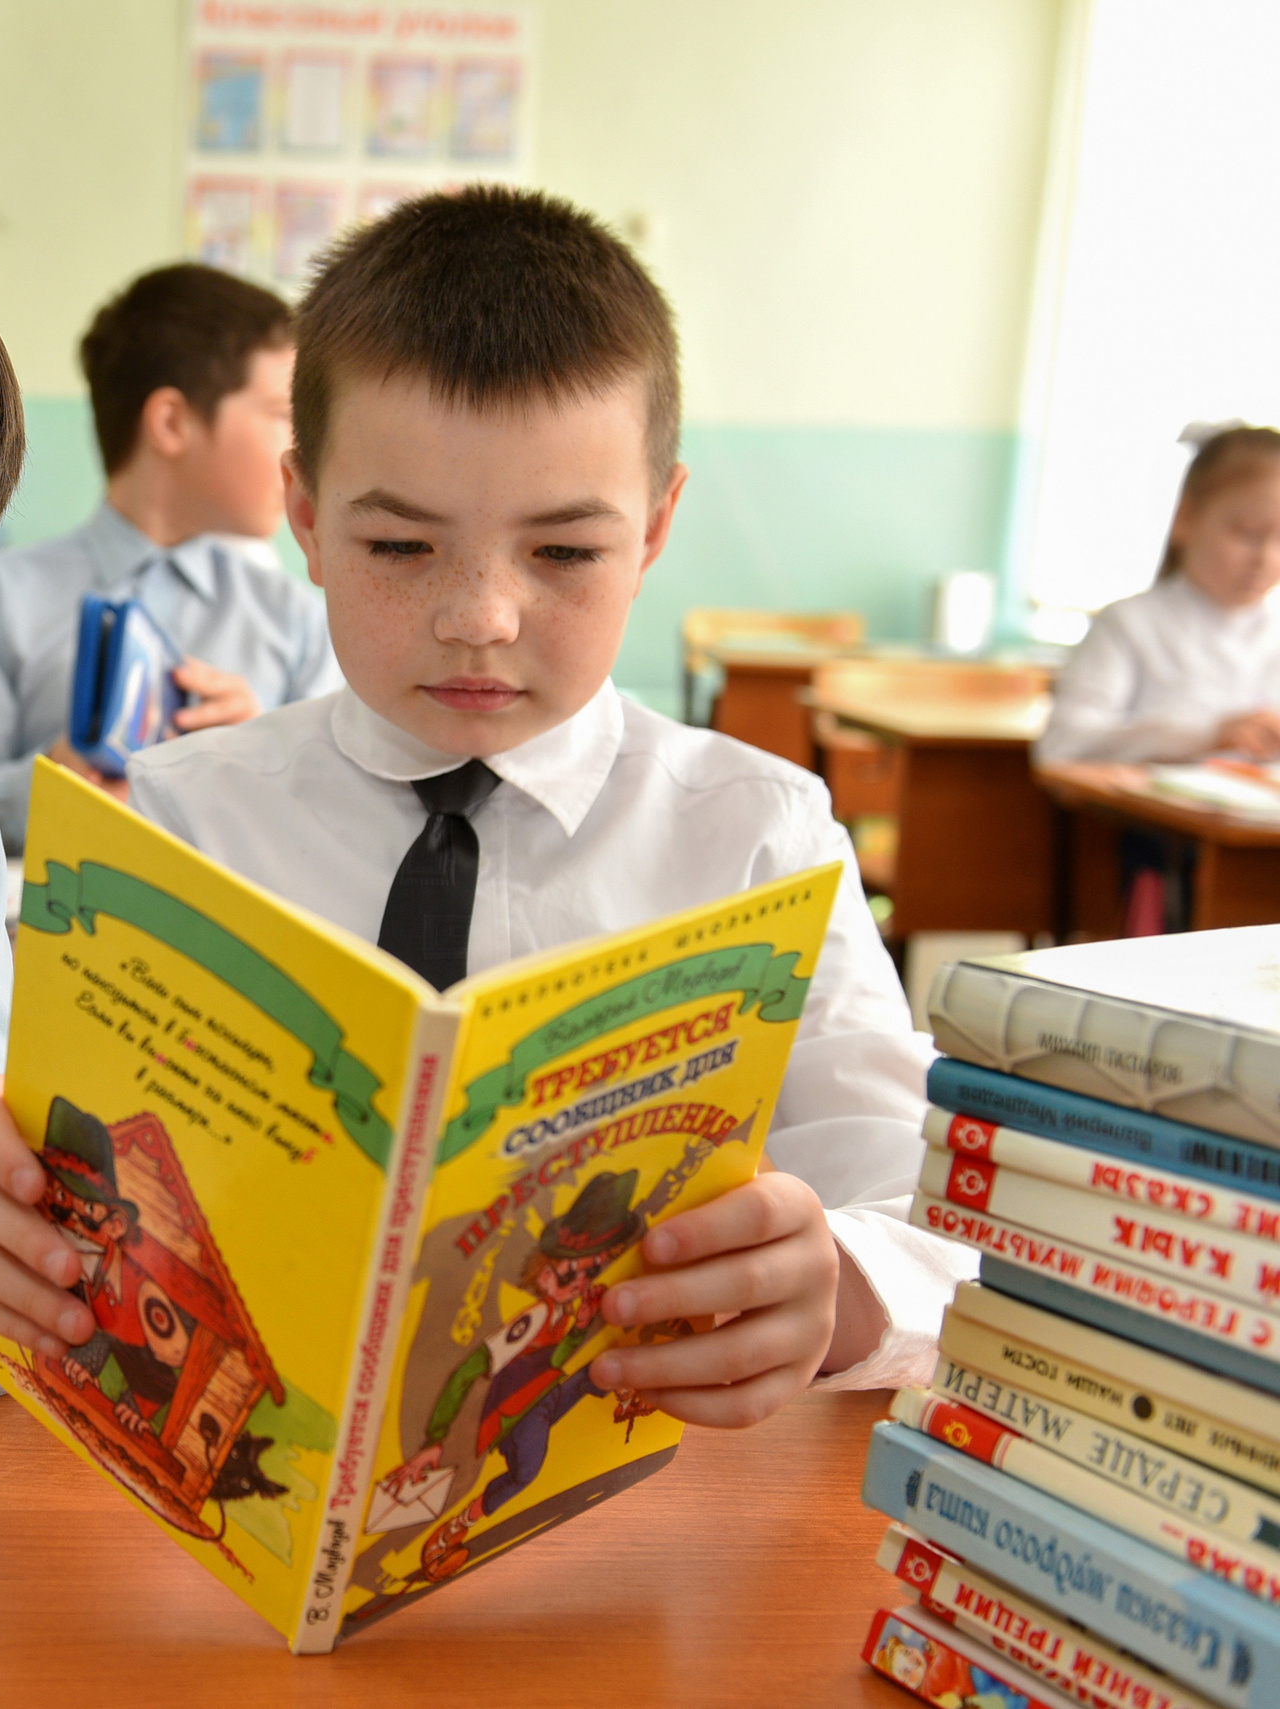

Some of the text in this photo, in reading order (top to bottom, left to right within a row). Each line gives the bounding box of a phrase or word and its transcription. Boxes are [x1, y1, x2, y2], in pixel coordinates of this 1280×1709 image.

[675, 890, 812, 949] ШКОЛЬНИКА
[529, 1001, 736, 1110] ТРЕБУЕТСЯ
[503, 1039, 740, 1157] СООБЩНИК ДЛЯ
[956, 1084, 1154, 1154] Валерий Медведев
[453, 1103, 740, 1260] ПРЕСТУПЛЕНИЯ
[327, 1397, 372, 1509] Требуется
[356, 1281, 394, 1396] сообщник
[389, 1052, 440, 1233] преступления
[926, 1205, 1085, 1279] МУЛЬТИКОВ
[1113, 1215, 1234, 1279] КЛЫК
[1092, 1262, 1240, 1336] ГЕРОЯМИ
[1251, 1321, 1276, 1348] С
[1002, 1344, 1059, 1379] ГОСТИ
[1066, 1368, 1124, 1405] НАШИ
[944, 1362, 1073, 1443] МАТЕРИ
[924, 1479, 991, 1536] кита
[1088, 1431, 1231, 1524] СЕРДЦЕ
[994, 1519, 1115, 1603] мудрого
[954, 1581, 1064, 1663] ГРЕЦИИ
[1115, 1579, 1221, 1671] Сказки
